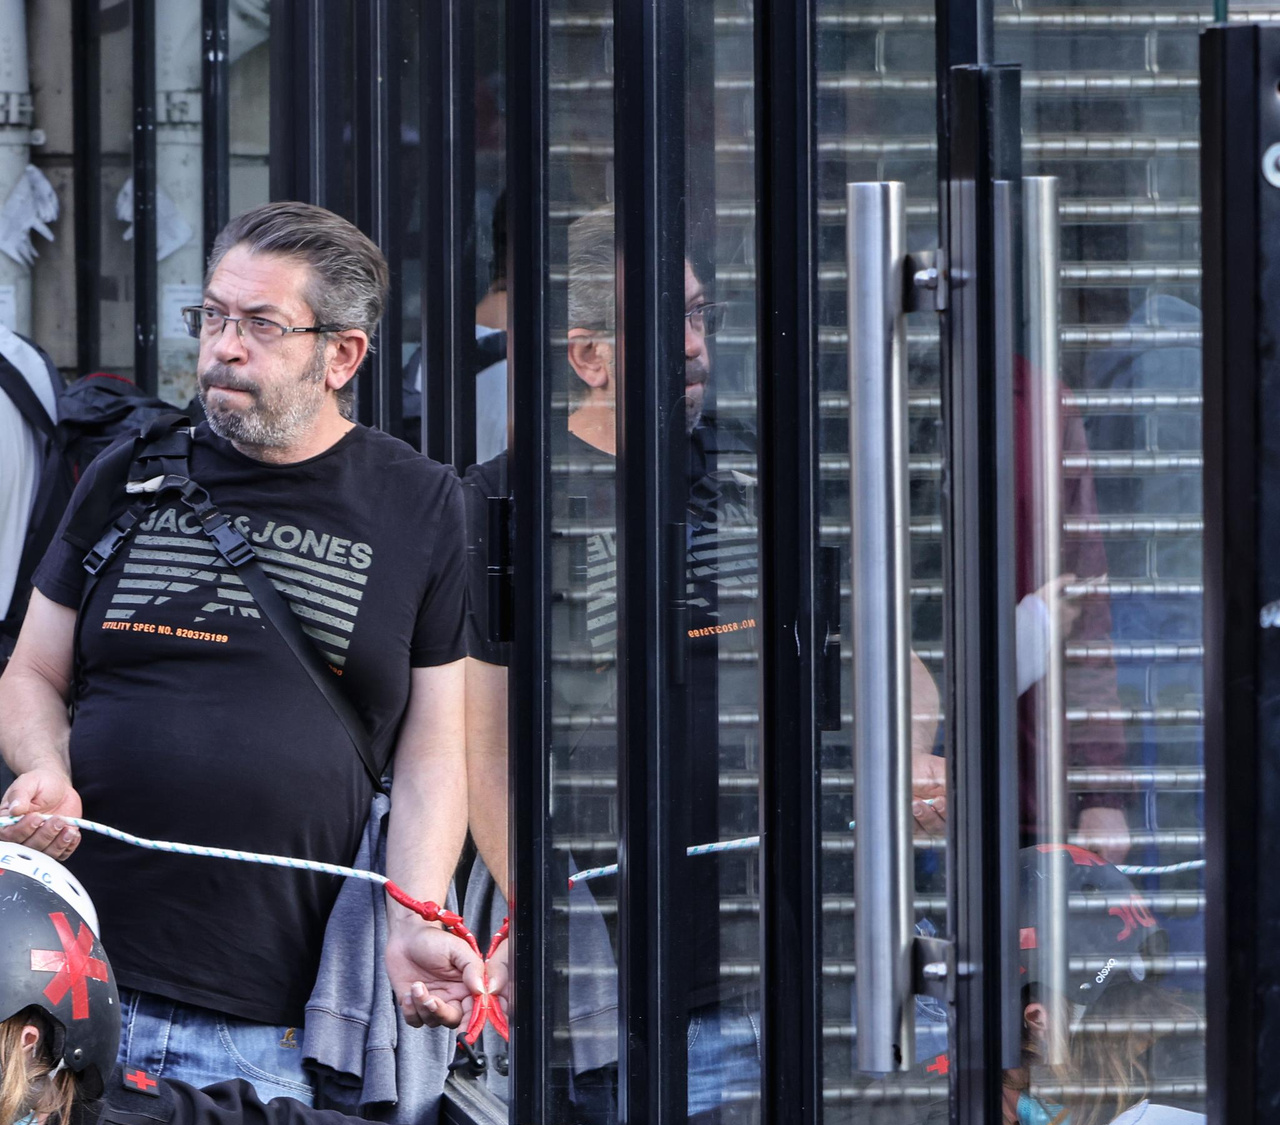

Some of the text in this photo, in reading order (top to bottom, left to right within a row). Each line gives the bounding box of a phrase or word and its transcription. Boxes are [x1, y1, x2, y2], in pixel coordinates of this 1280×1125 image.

[139, 508, 204, 535] JAC
[251, 521, 373, 570] JONES
[101, 621, 229, 643] UTILITY SPEC NO. 820375199
